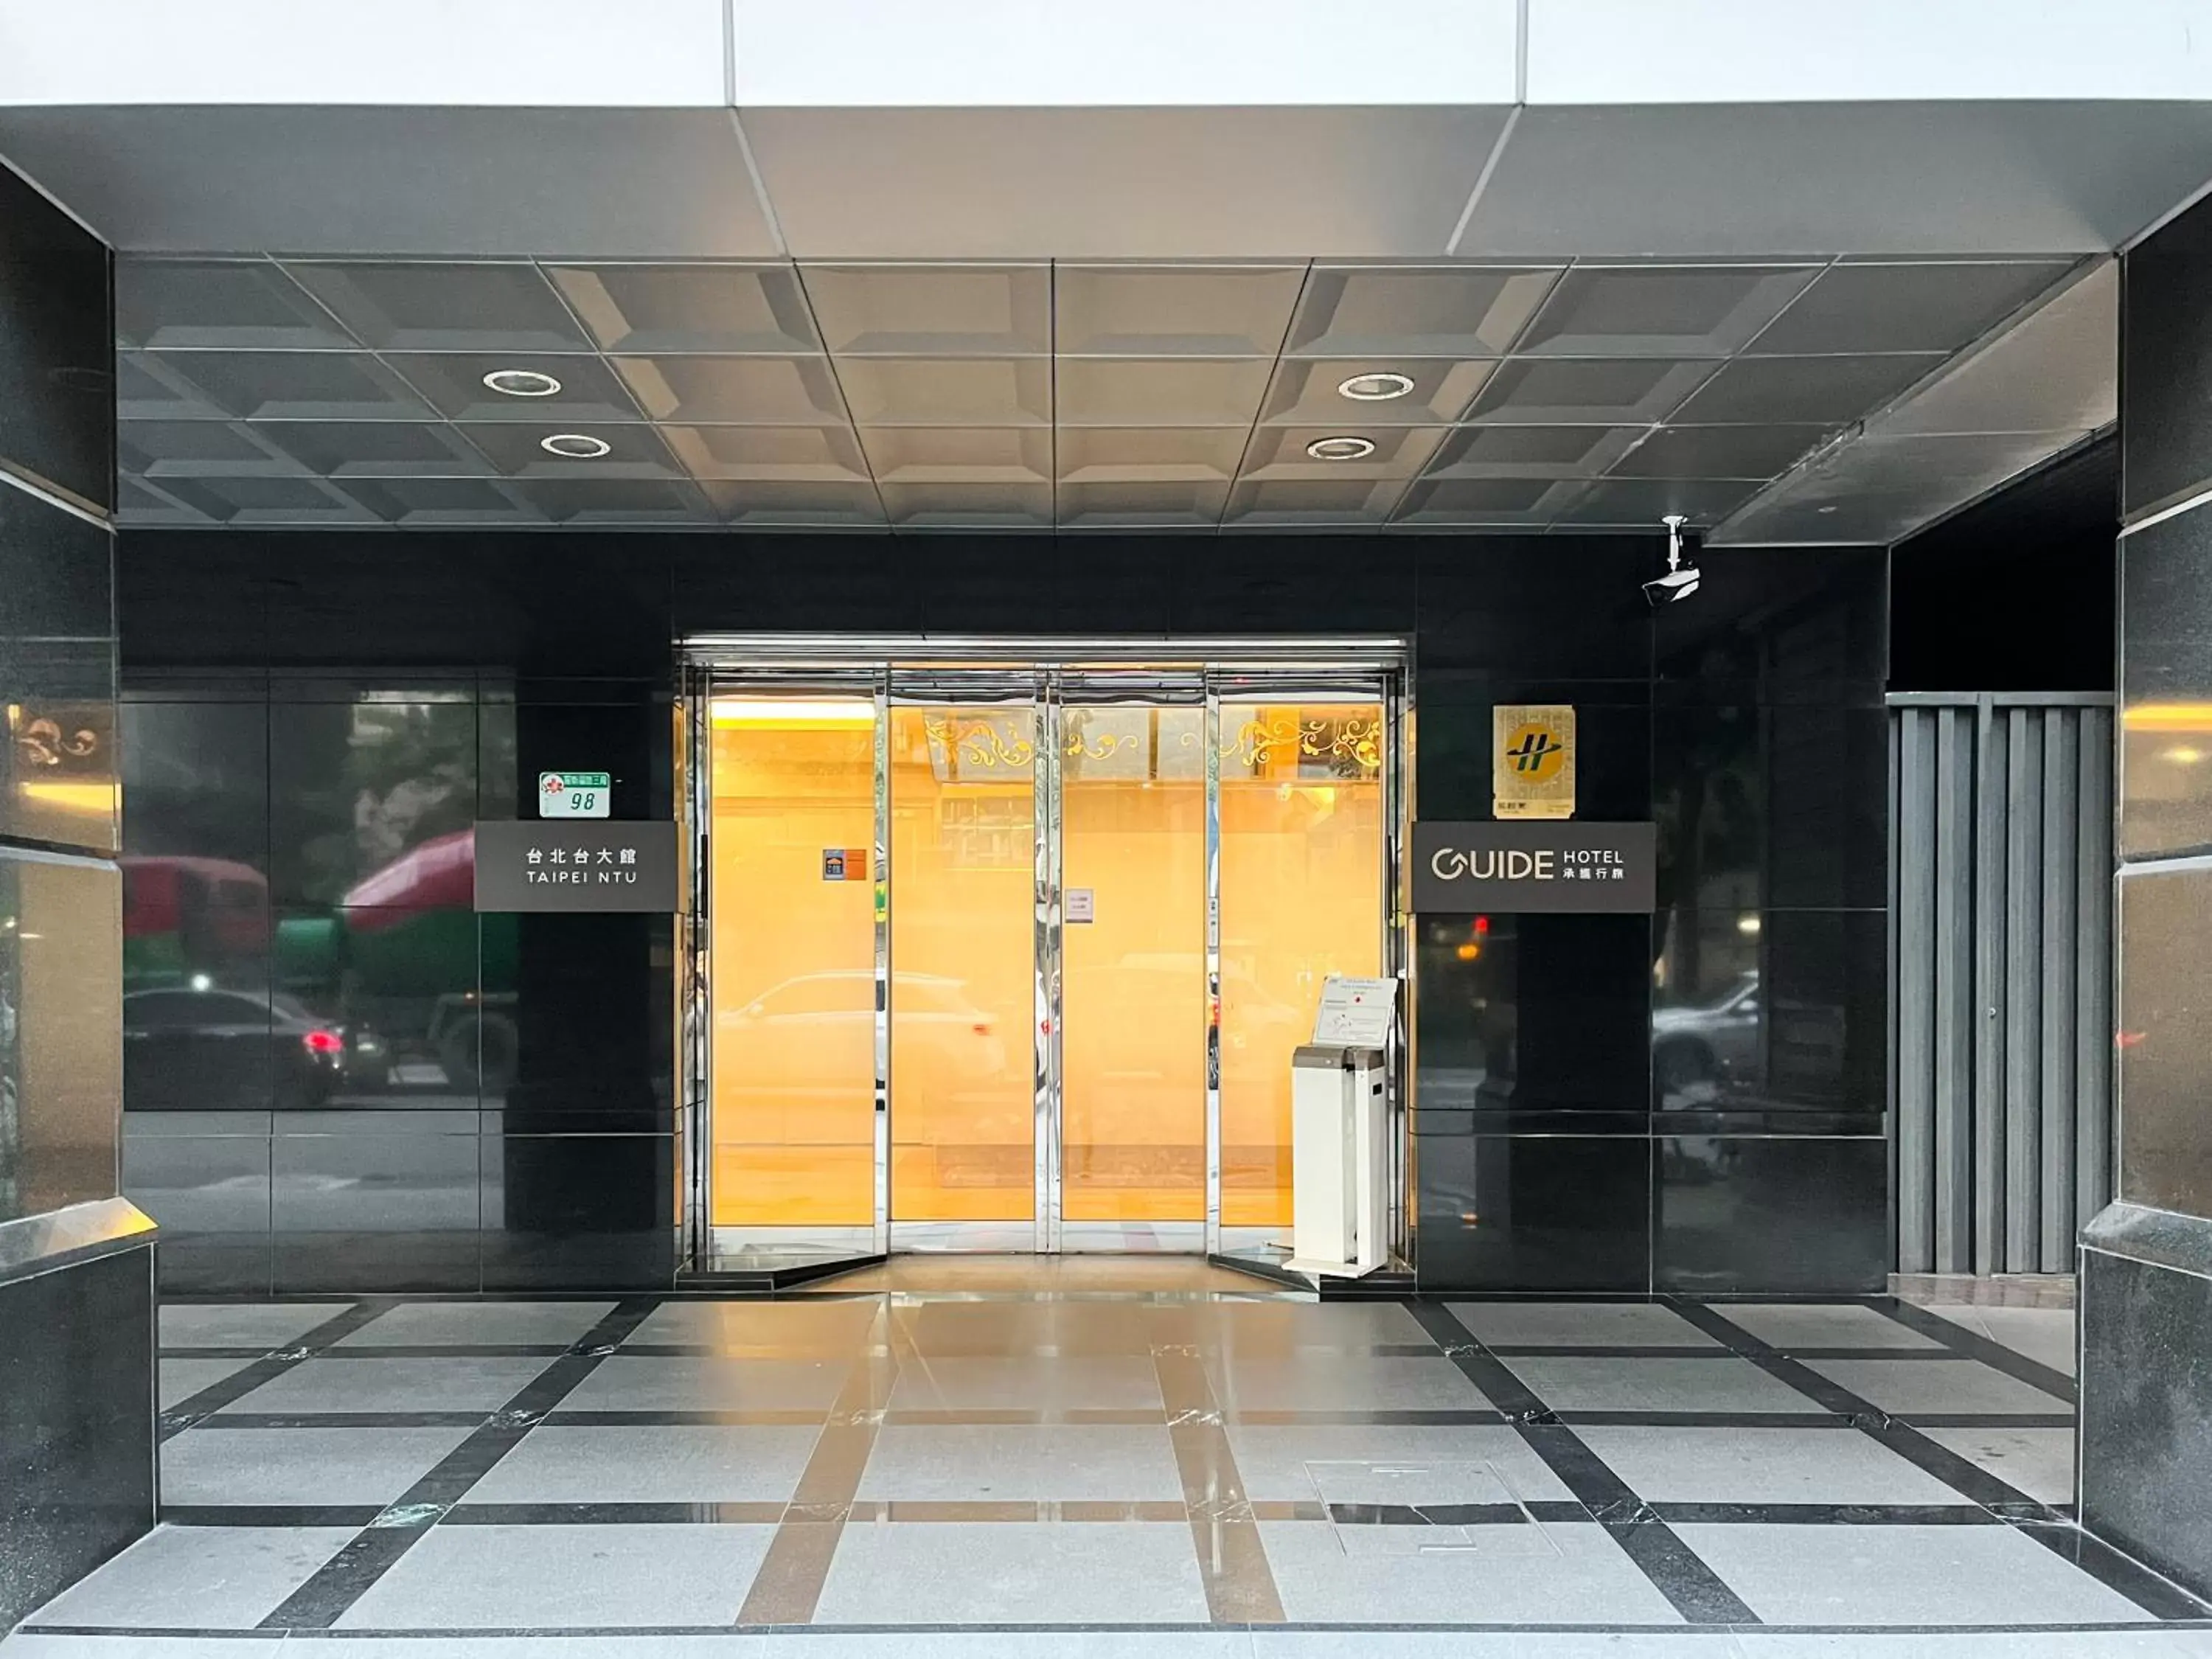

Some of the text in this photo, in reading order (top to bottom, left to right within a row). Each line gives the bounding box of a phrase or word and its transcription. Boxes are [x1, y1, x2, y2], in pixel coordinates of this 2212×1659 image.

[571, 793, 595, 810] 98
[526, 848, 637, 864] 台北台大館
[1431, 848, 1624, 880] GUIDE HOTEL
[526, 872, 637, 883] TAIPEI NTU
